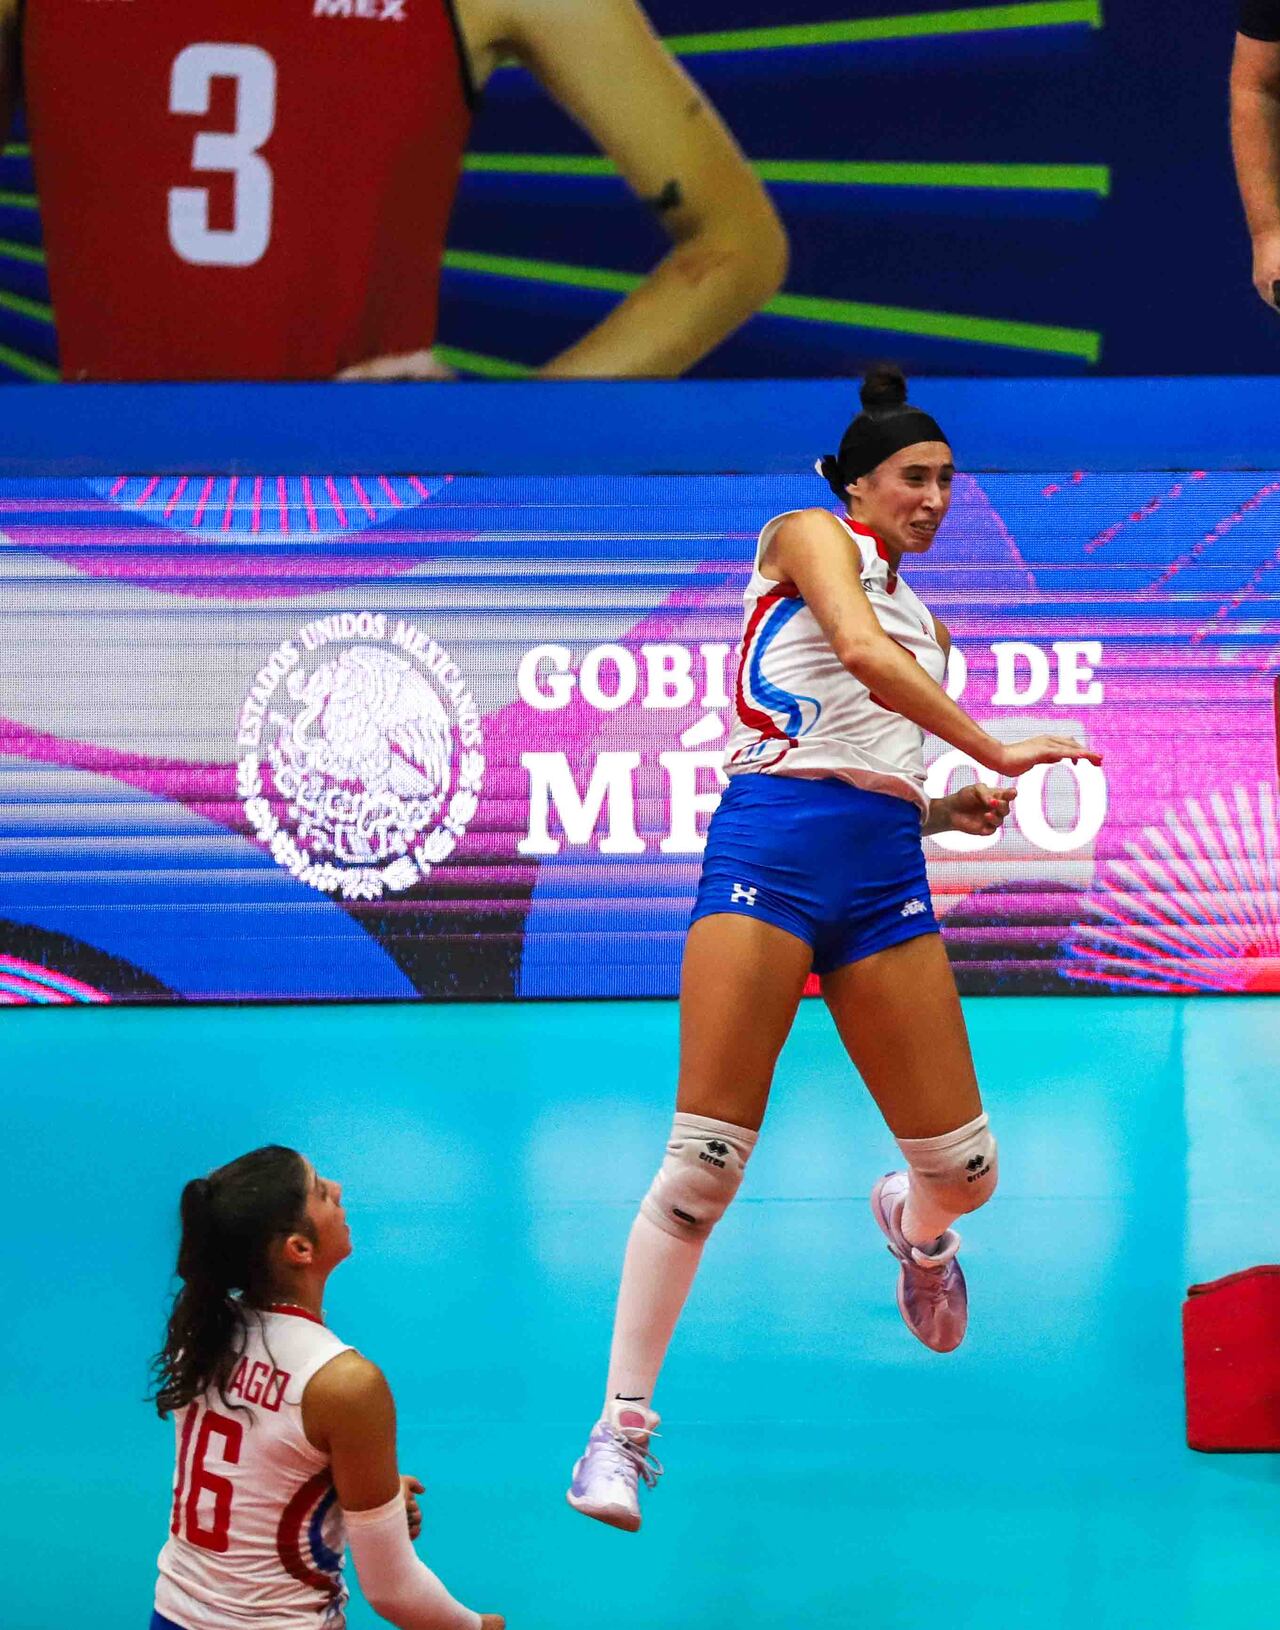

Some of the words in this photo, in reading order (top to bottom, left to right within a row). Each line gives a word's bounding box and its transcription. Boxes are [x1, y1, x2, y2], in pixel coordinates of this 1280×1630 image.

[168, 42, 277, 267] 3
[237, 639, 301, 746] ESTADOS
[299, 611, 388, 651] UNIDOS
[391, 619, 484, 747] MEXICANOS
[990, 641, 1104, 705] DE
[170, 1402, 243, 1553] 16
